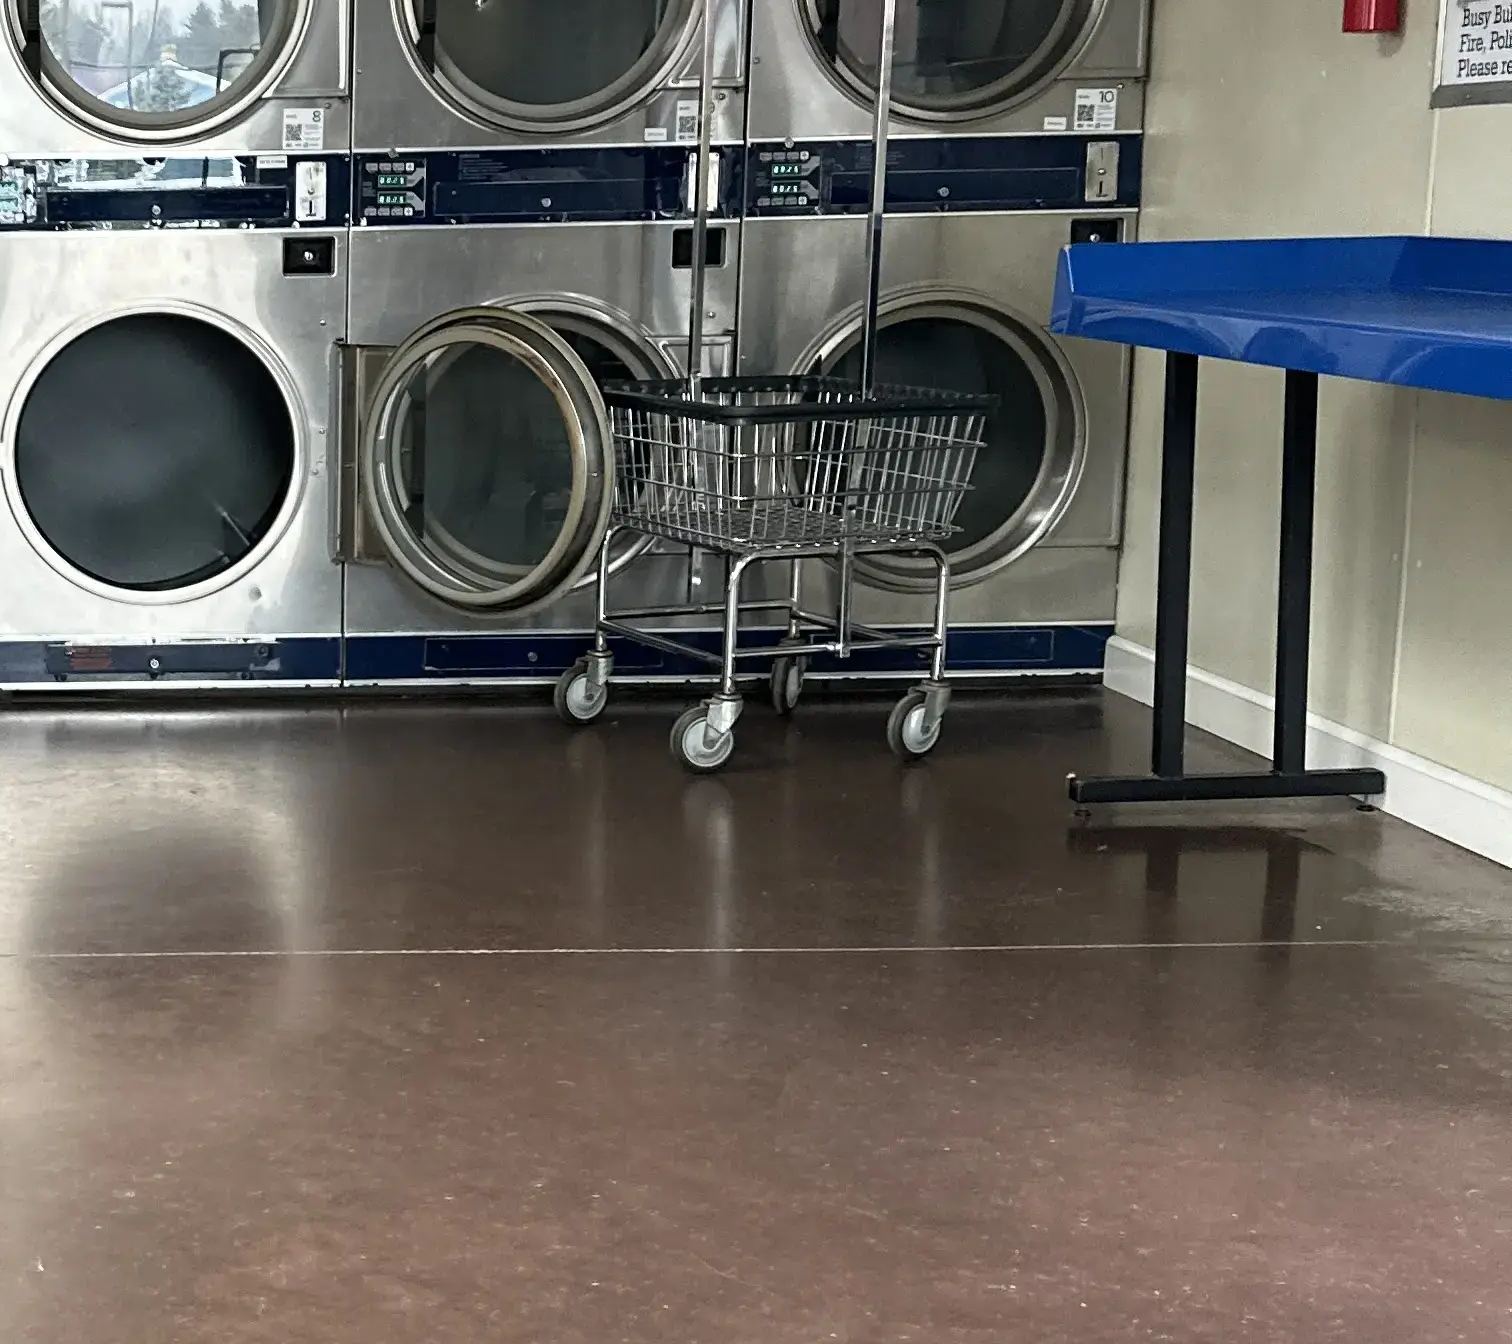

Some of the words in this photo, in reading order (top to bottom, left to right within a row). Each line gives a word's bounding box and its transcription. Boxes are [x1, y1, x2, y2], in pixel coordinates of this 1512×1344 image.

[1462, 8, 1492, 30] Busy
[1459, 33, 1487, 55] Fire,
[1457, 58, 1499, 78] Please
[1098, 90, 1115, 103] 10
[312, 110, 322, 123] 8
